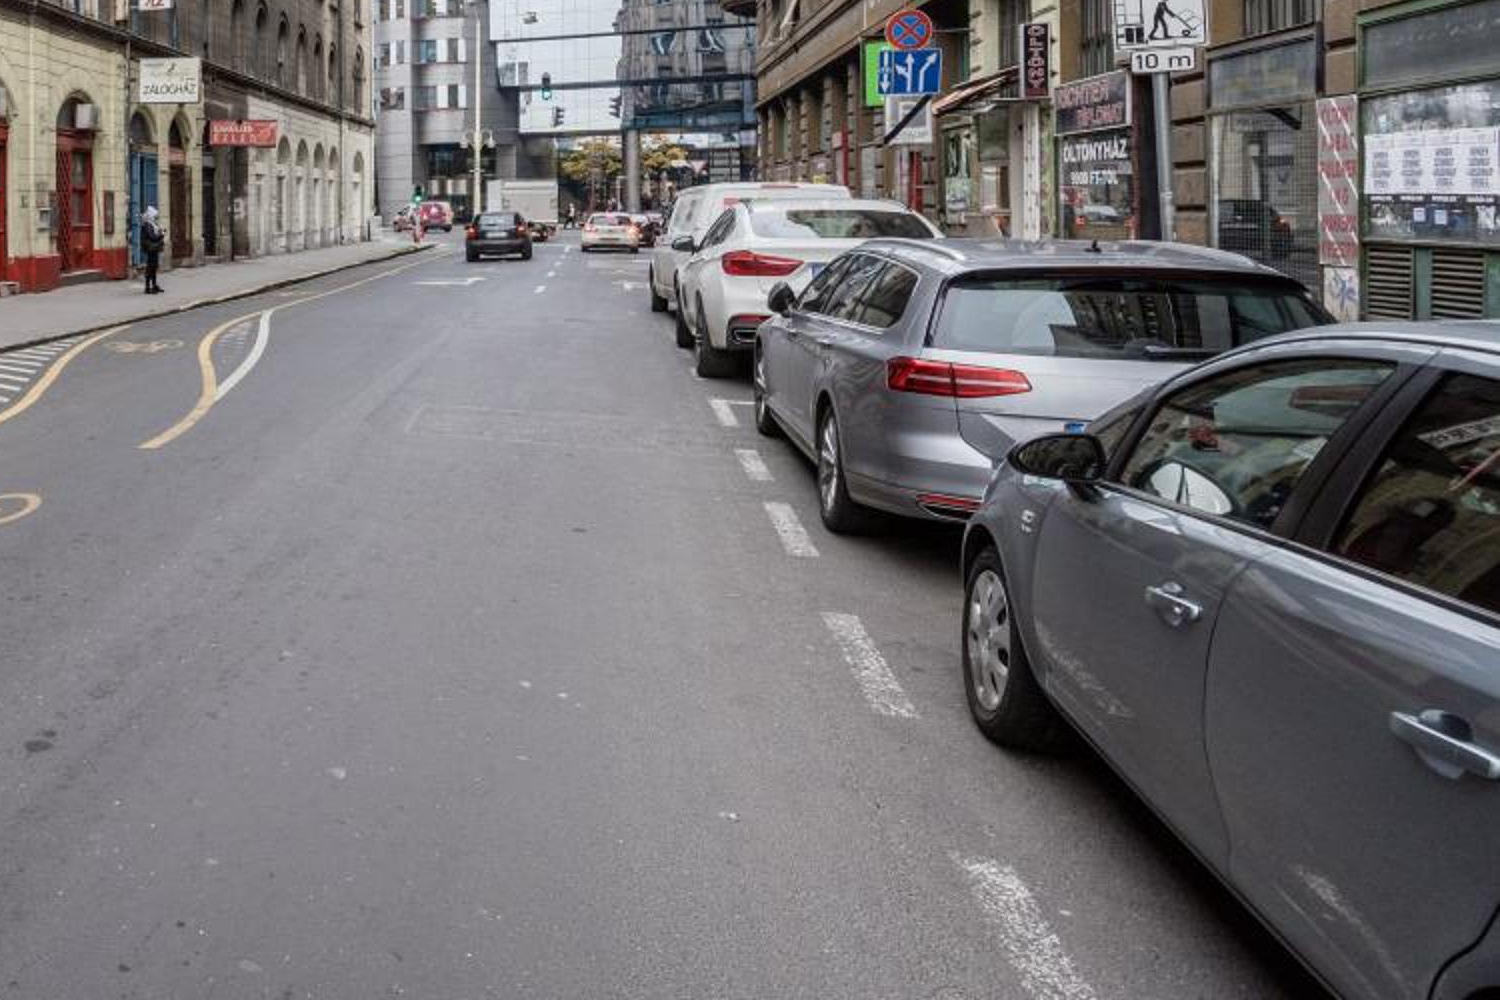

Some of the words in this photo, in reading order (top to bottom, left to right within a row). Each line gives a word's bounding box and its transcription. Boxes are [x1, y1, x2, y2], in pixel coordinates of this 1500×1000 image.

[1136, 53, 1159, 70] 10
[1168, 55, 1191, 68] m
[1062, 135, 1128, 163] ÖLTÖNYHÁZ
